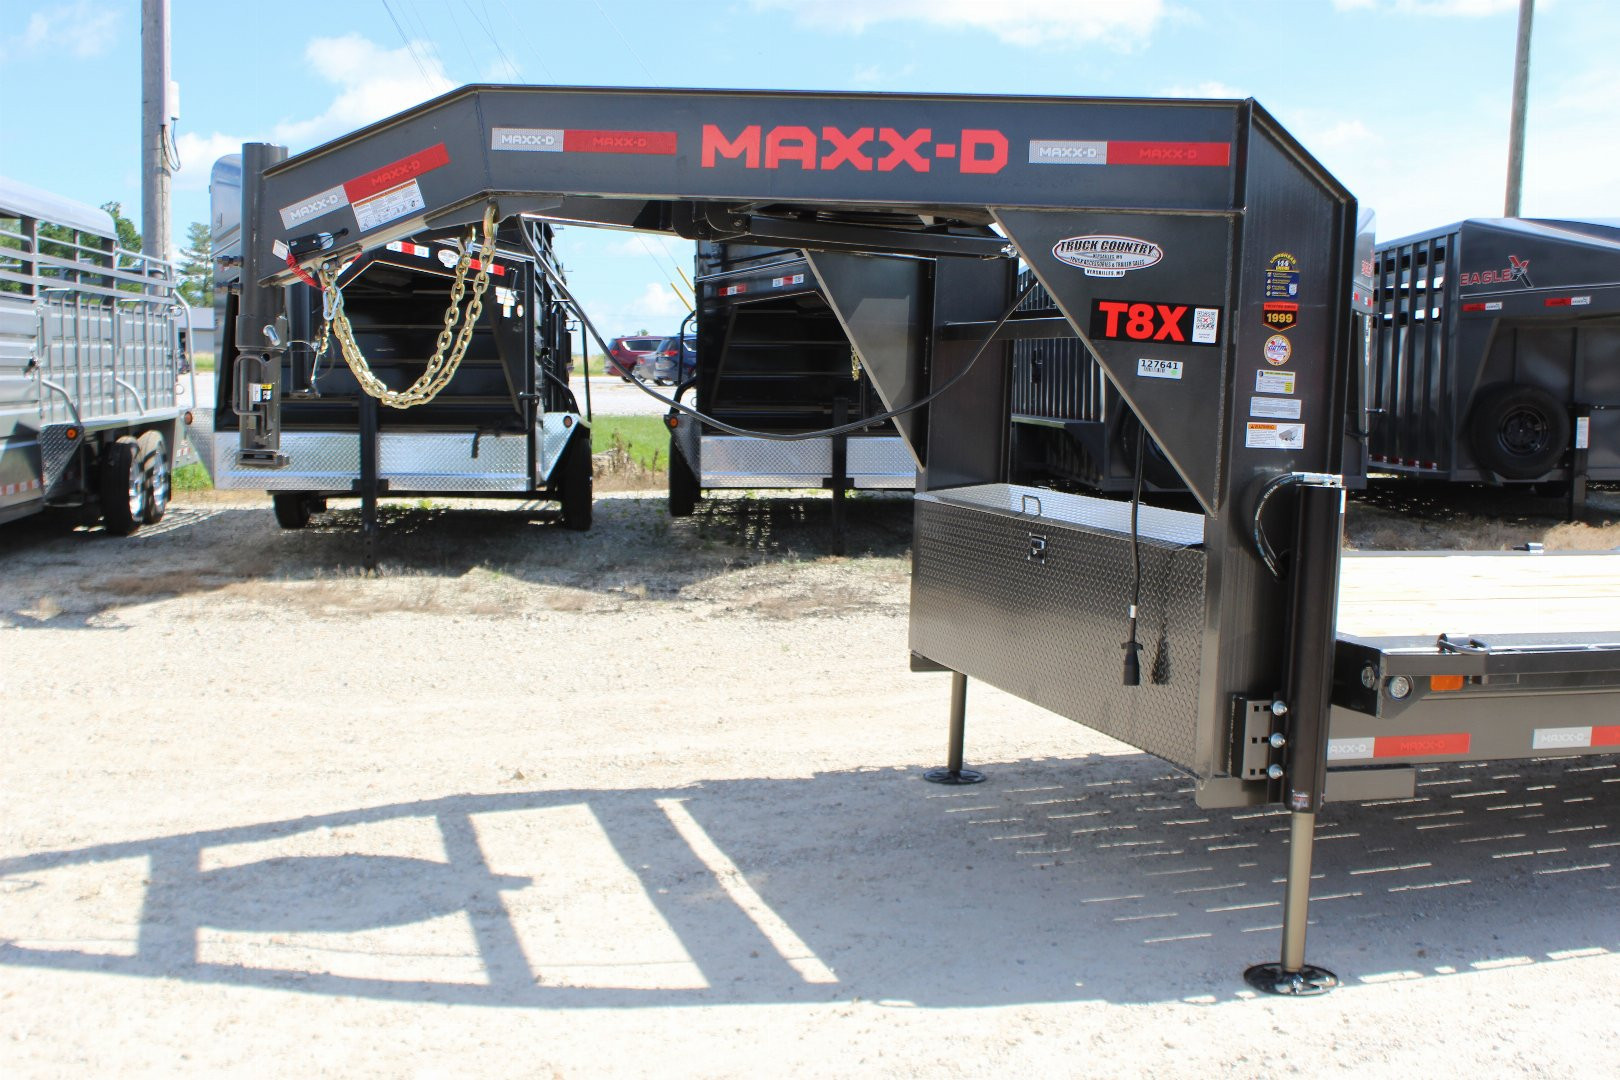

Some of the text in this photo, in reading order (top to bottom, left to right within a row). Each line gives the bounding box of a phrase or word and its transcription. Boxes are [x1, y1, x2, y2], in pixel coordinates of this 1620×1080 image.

[501, 134, 555, 146] MAXX-D
[592, 137, 647, 147] MAXX-D
[701, 124, 1009, 174] MAXX-D
[1039, 146, 1097, 159] MAXX-D
[1139, 148, 1198, 160] MAXX-D
[371, 159, 421, 186] MAXX-D
[290, 194, 339, 221] MAXX-D
[1060, 240, 1157, 255] TRUCK COUNTRY
[1098, 301, 1188, 342] T8X
[1266, 313, 1293, 323] 1999
[1141, 359, 1178, 370] 127641
[1541, 732, 1585, 743] MAXX-D
[1328, 743, 1367, 754] AXX-D
[1400, 739, 1446, 751] MAXX-D
